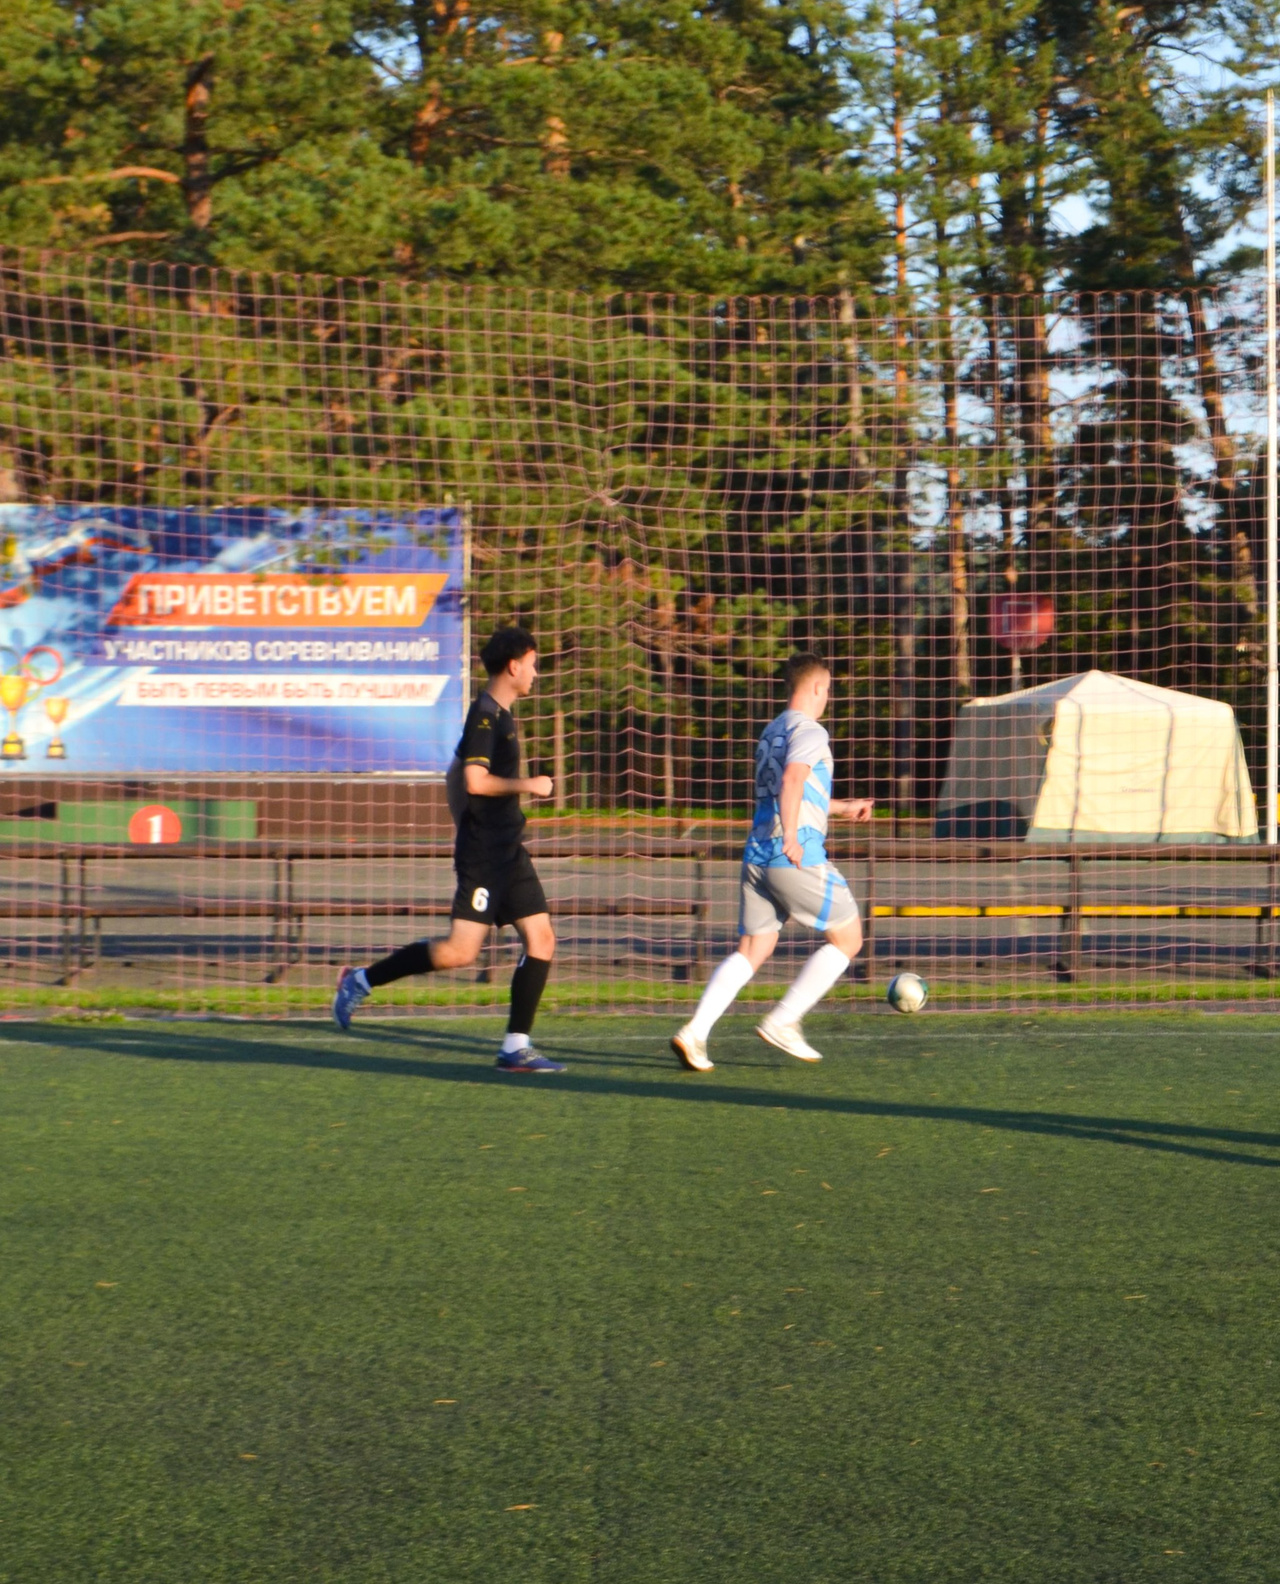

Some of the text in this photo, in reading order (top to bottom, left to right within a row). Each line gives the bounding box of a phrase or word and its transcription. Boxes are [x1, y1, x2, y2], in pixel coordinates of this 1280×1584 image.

[138, 584, 416, 616] ПРИВЕТСТВУЕМ
[104, 637, 440, 661] УЧАСТНИКОВ СОРЕВНОВАНИЙ!
[138, 682, 189, 698] БЫТЬ
[194, 682, 277, 698] ПЕРВЫМ
[283, 682, 332, 698] БЫТЬ
[147, 814, 162, 843] 1
[472, 887, 489, 912] 6
